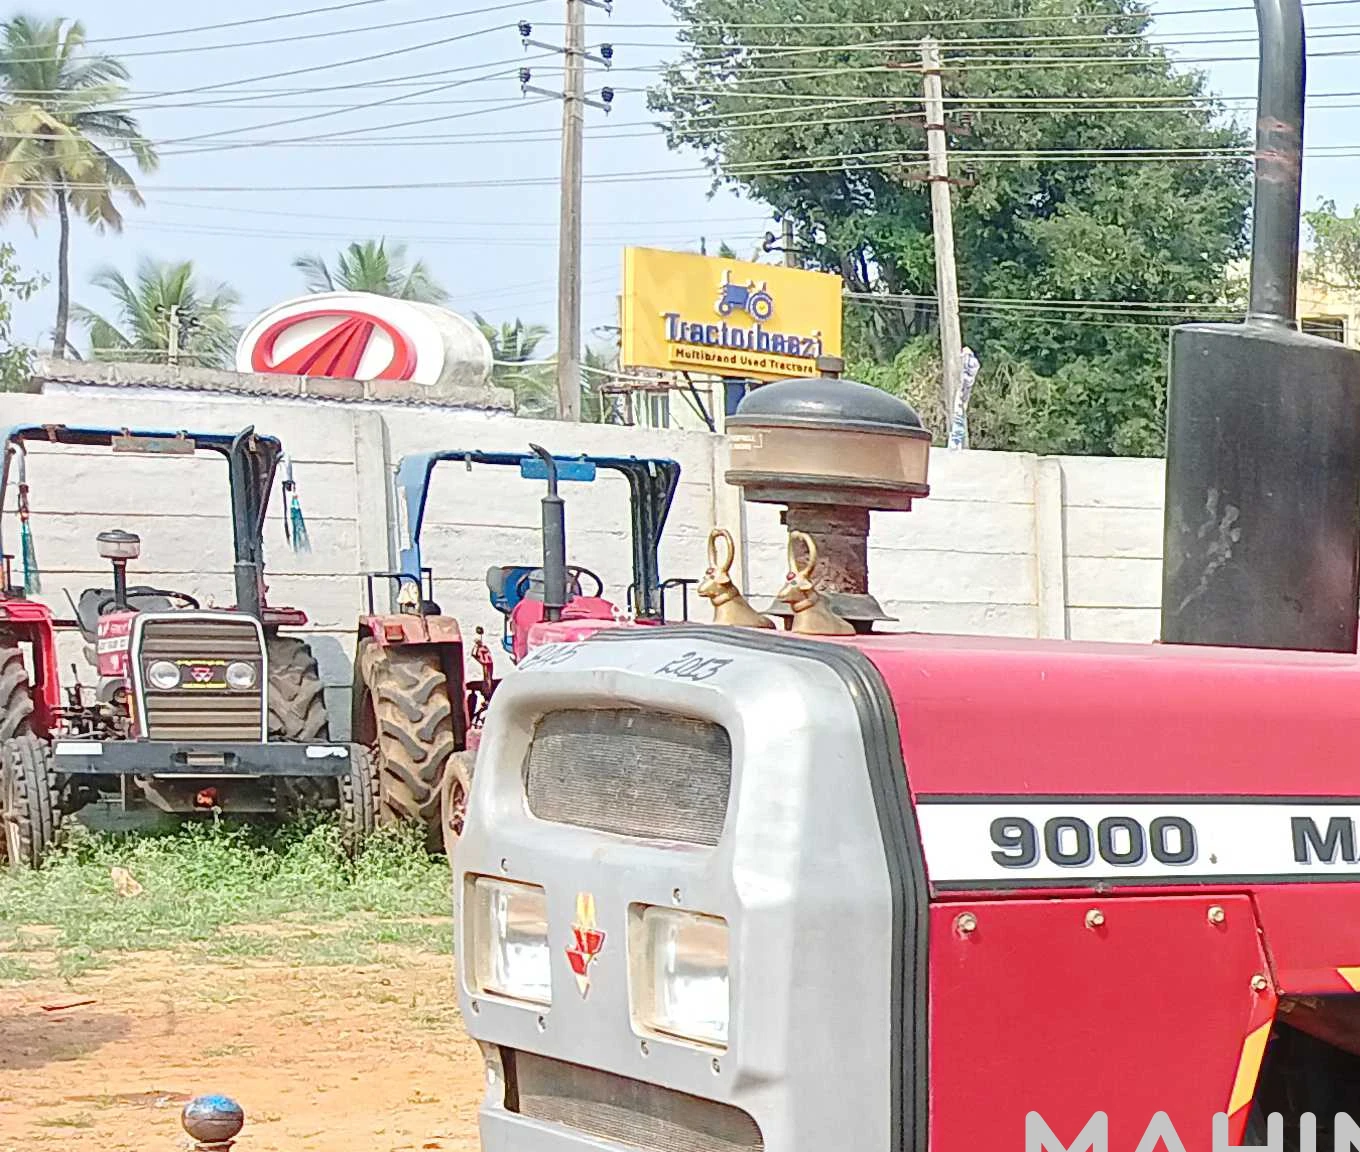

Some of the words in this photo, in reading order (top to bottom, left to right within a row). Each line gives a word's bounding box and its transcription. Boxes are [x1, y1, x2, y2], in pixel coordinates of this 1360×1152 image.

[675, 347, 737, 364] Multibrand
[739, 354, 767, 368] Used
[769, 358, 814, 374] Tractors
[989, 816, 1202, 868] 9000
